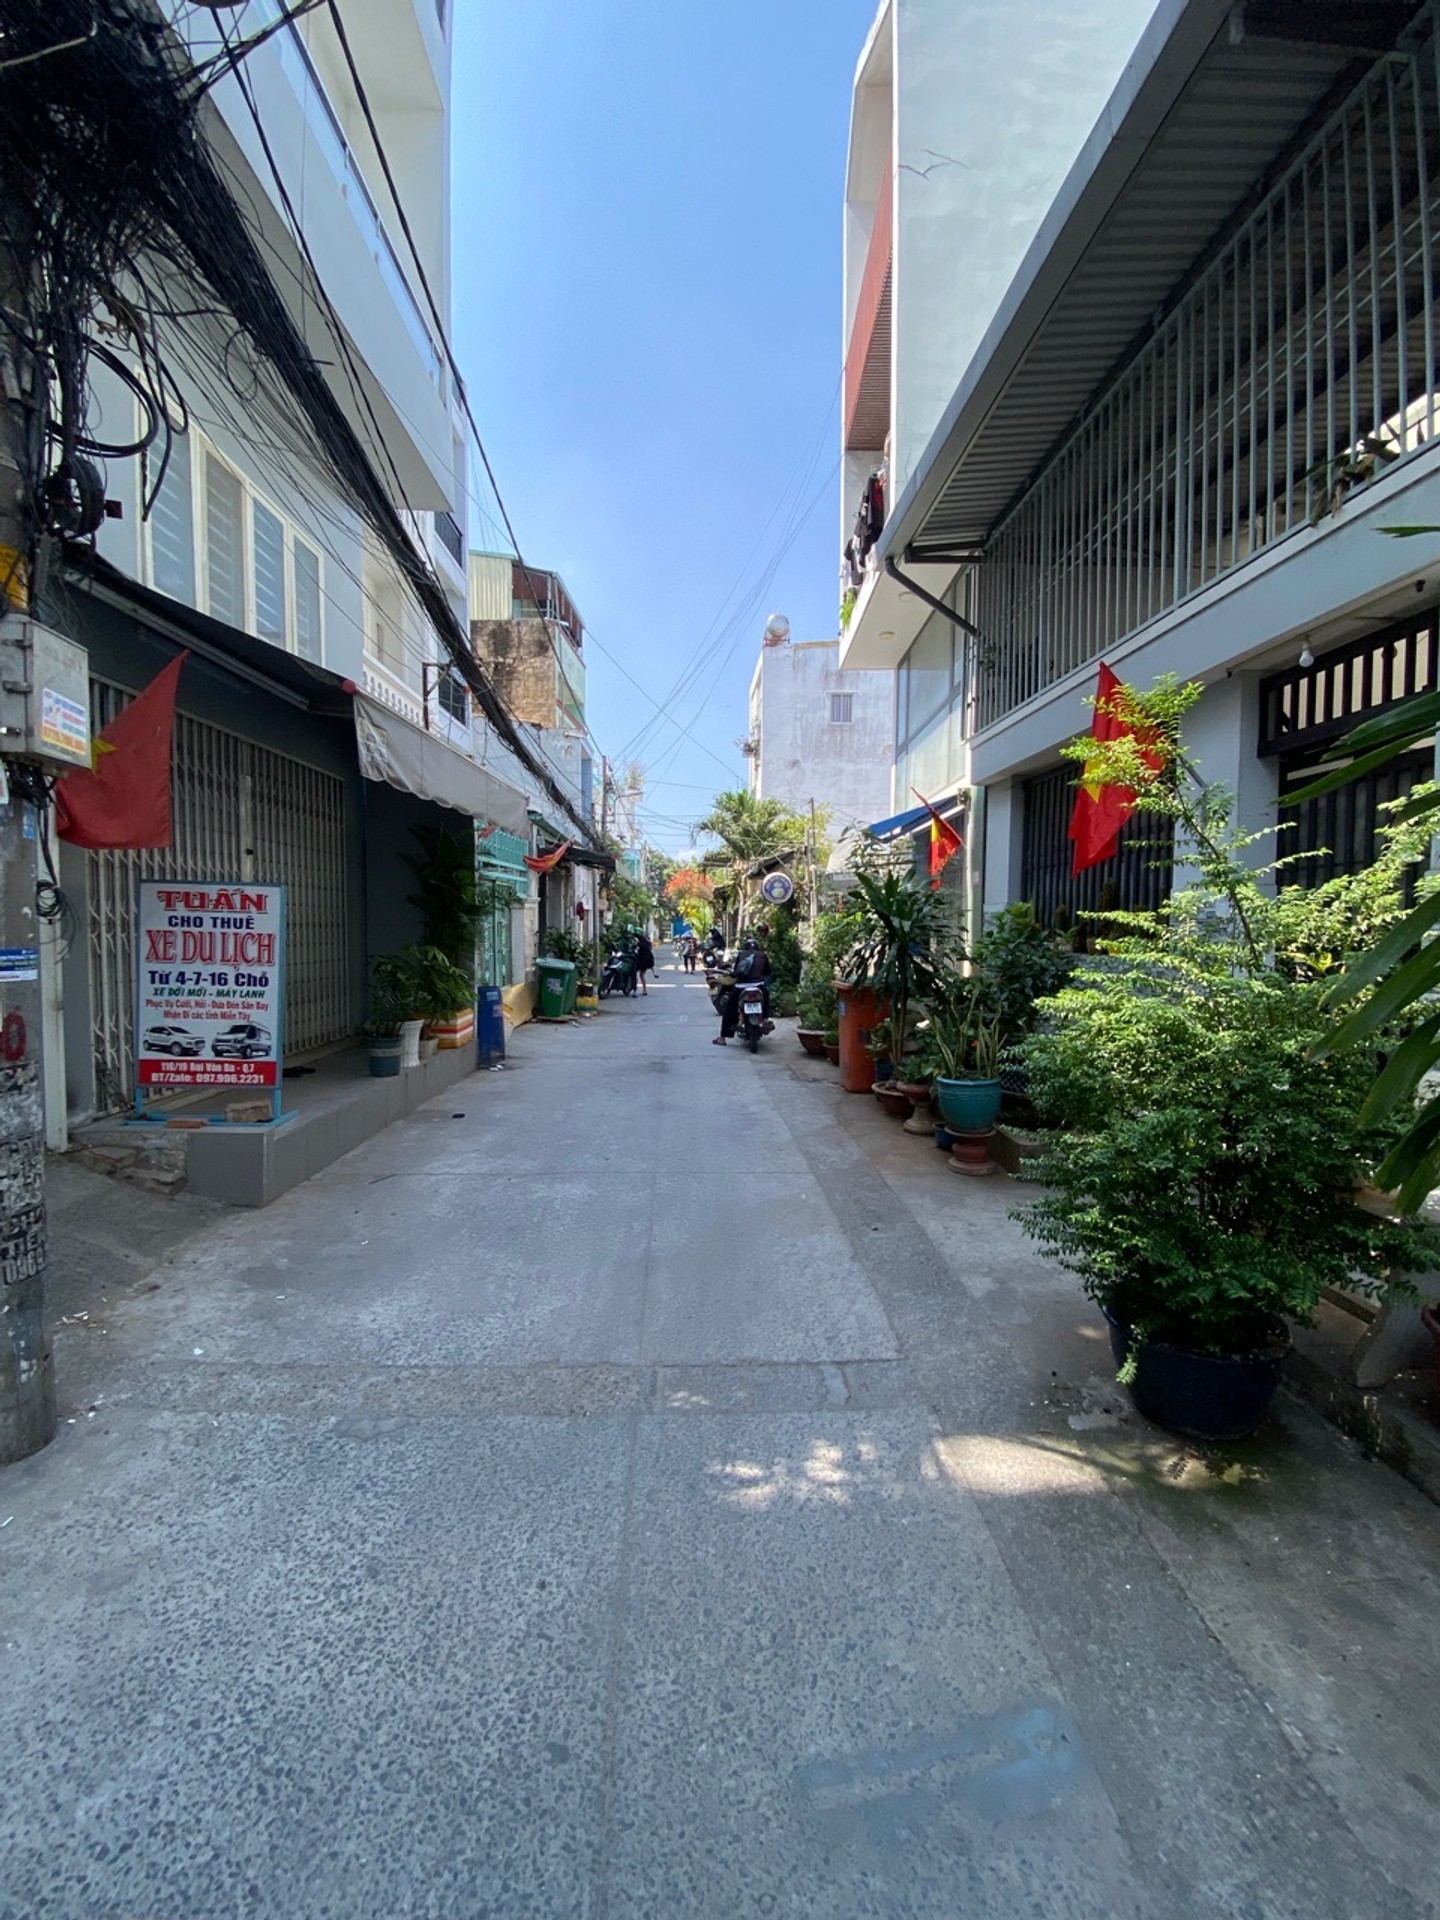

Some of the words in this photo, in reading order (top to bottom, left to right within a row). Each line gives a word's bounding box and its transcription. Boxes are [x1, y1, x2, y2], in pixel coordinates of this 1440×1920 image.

[157, 888, 268, 914] TUẤN
[168, 915, 204, 928] CHO
[210, 915, 255, 930] THUÊ
[145, 929, 178, 964] XE
[181, 930, 217, 965] DU
[220, 931, 276, 971] LỊCH
[148, 970, 172, 985] Từ
[175, 971, 229, 987] 4-7-16
[153, 987, 166, 997] XE
[215, 988, 237, 998] MÁY
[256, 1001, 269, 1012] Bay
